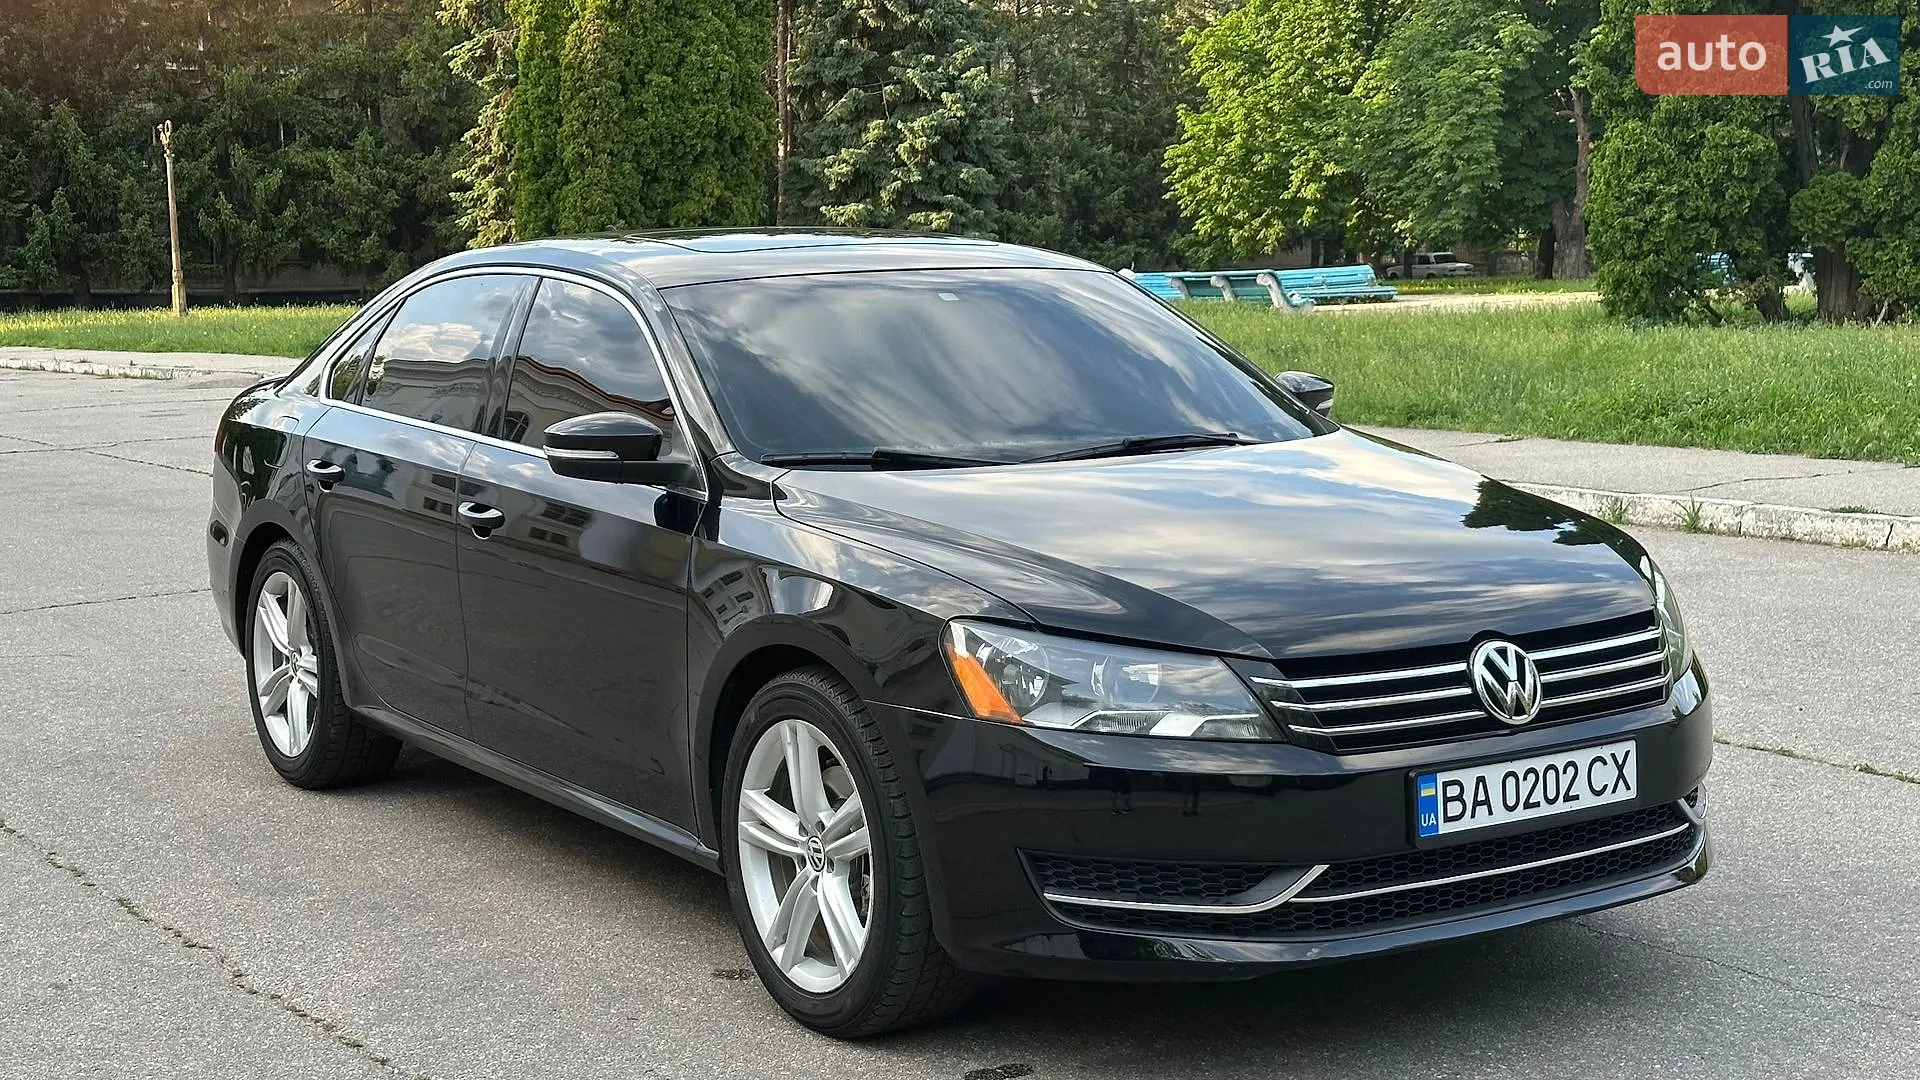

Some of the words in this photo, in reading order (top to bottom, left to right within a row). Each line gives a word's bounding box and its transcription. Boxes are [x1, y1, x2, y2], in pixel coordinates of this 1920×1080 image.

[1441, 775, 1494, 824] BA
[1501, 760, 1580, 813] 0202
[1586, 749, 1632, 797] CX
[1421, 813, 1437, 827] UA
